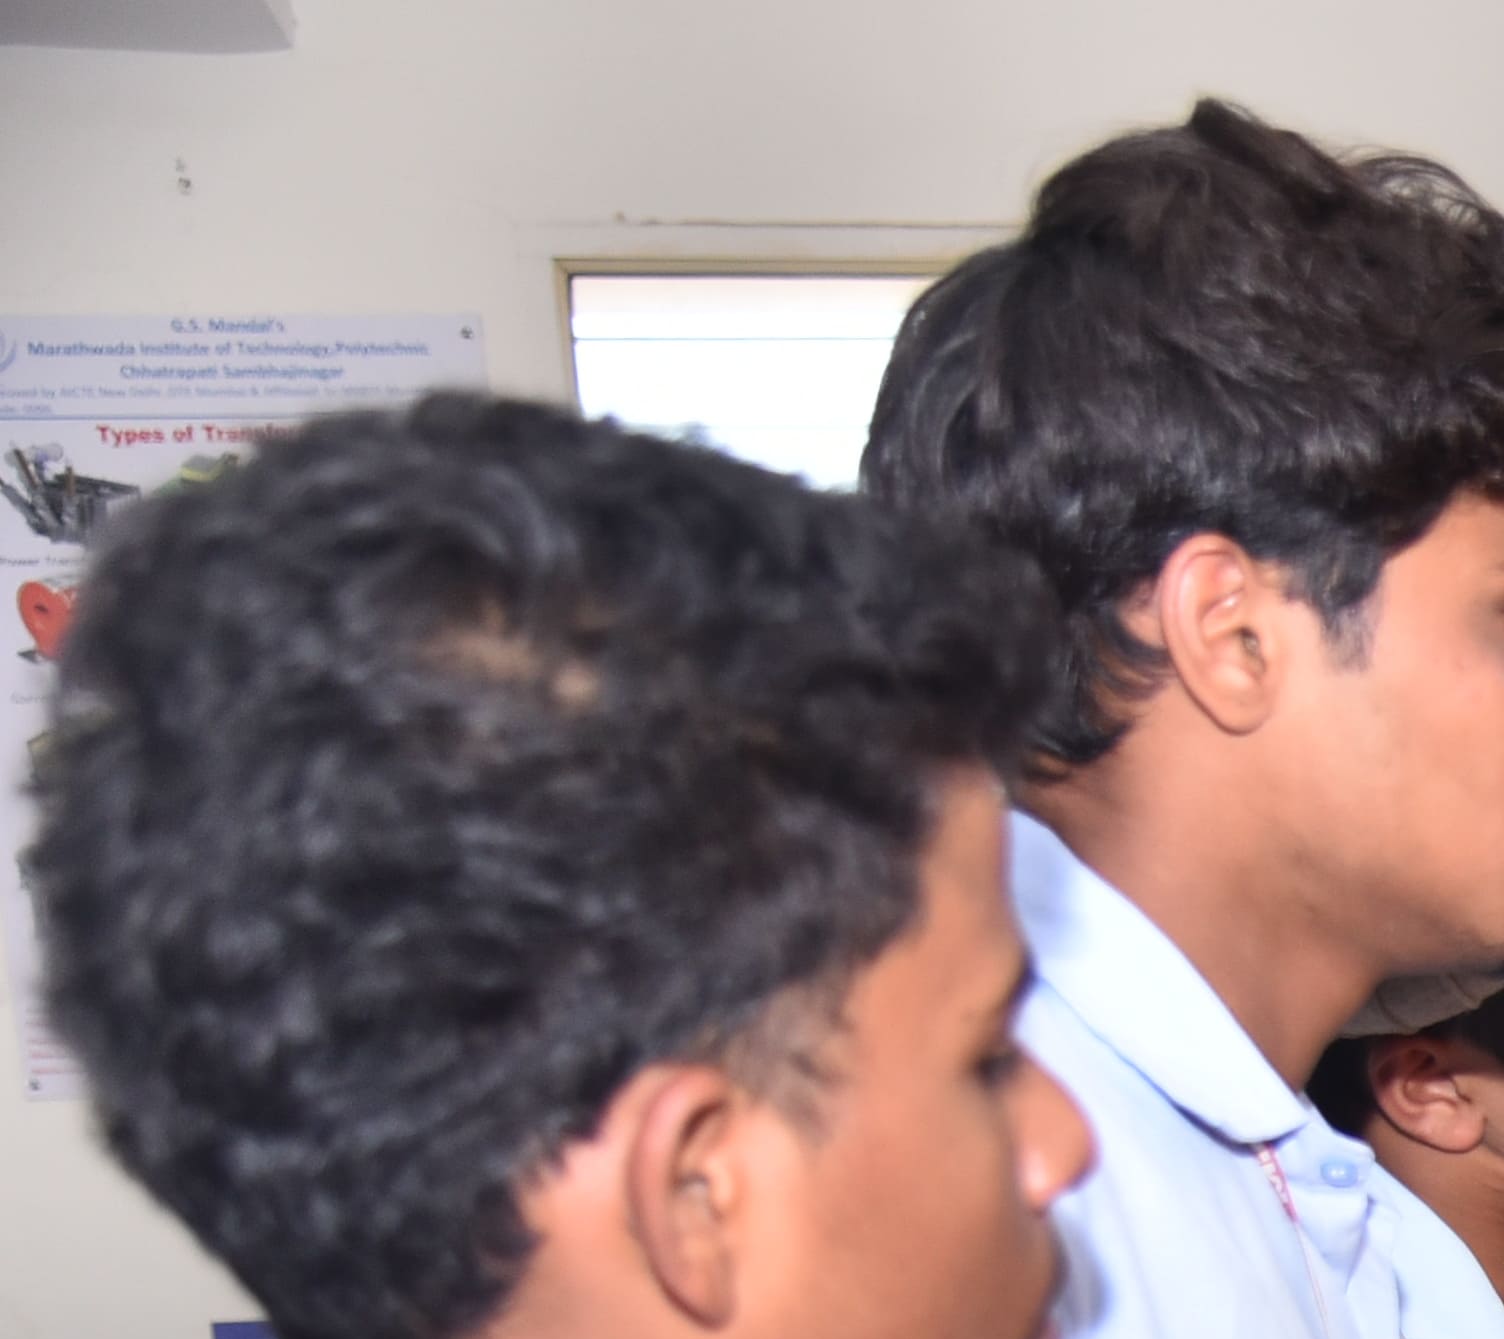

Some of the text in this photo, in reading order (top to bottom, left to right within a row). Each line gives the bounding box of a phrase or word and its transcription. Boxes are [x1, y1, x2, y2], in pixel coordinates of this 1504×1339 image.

[27, 341, 136, 357] Marathwada
[215, 341, 232, 356] of
[120, 364, 344, 381] Chhatrapati Sambhajinagar
[97, 425, 193, 446] Types of
